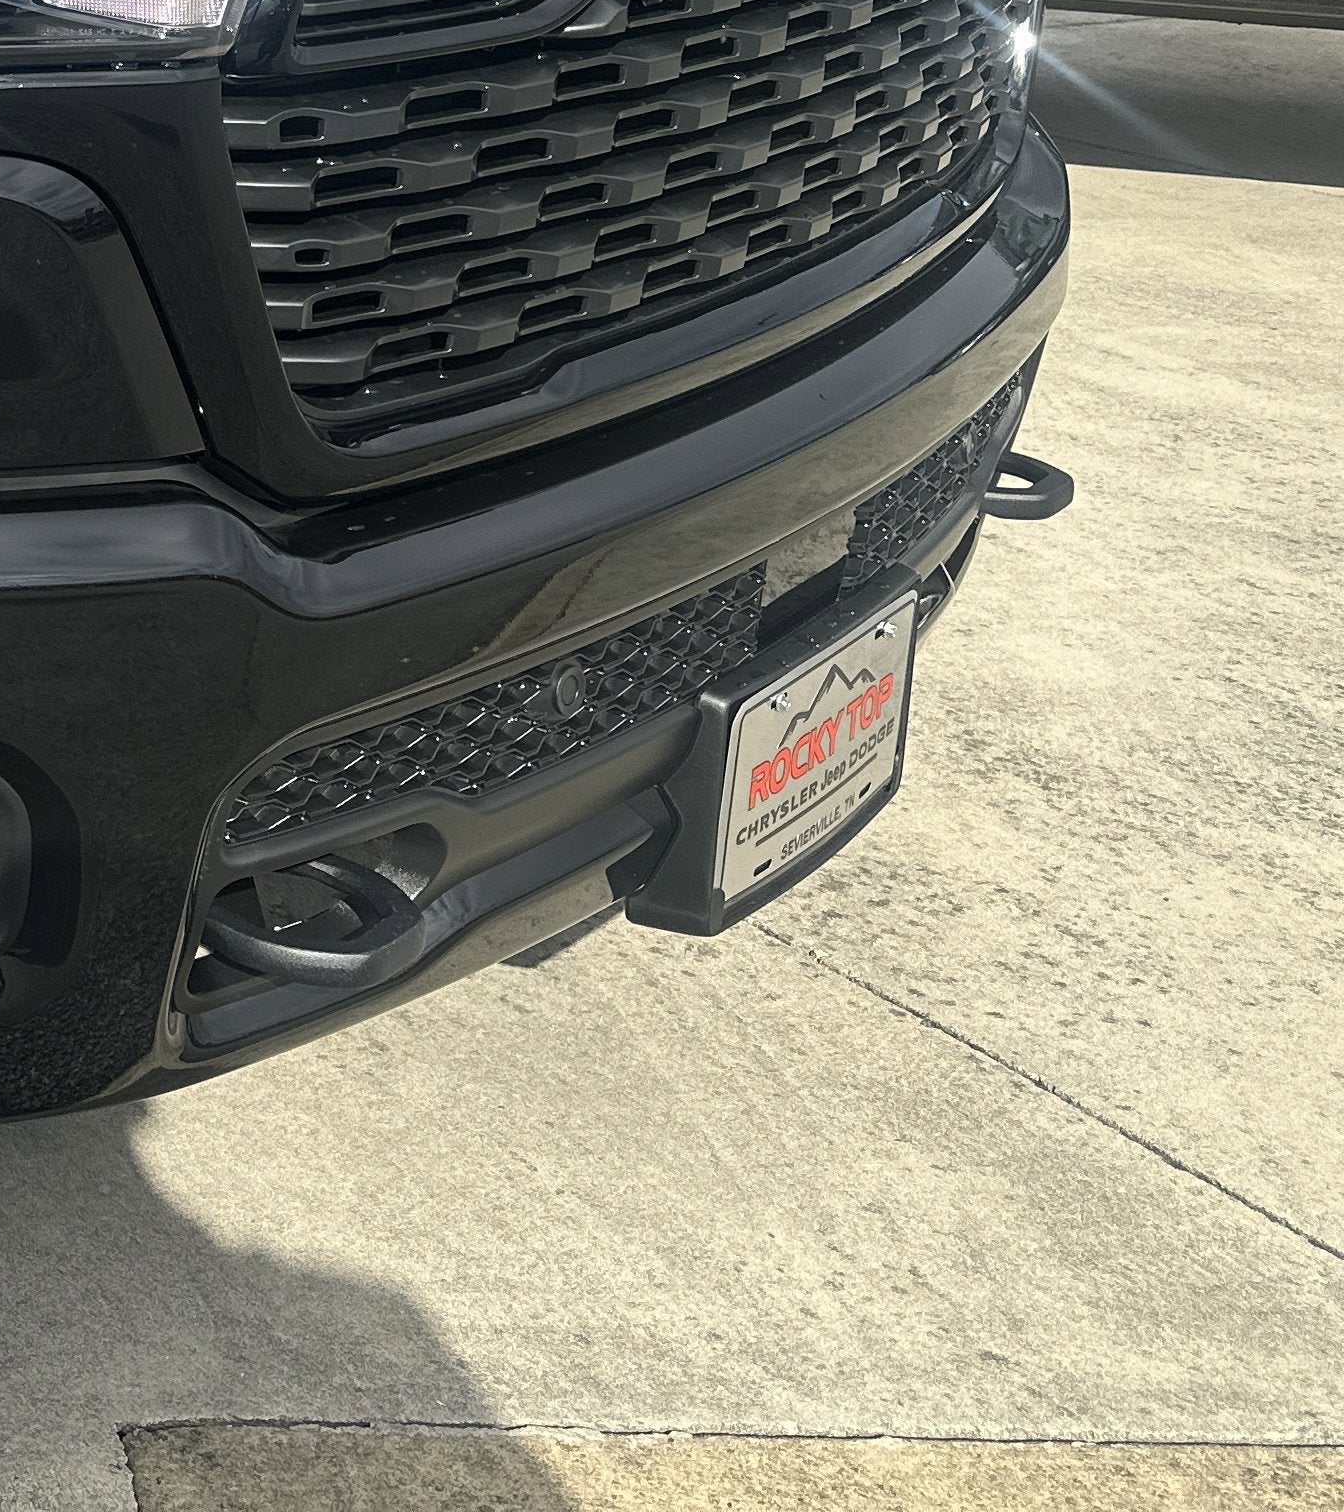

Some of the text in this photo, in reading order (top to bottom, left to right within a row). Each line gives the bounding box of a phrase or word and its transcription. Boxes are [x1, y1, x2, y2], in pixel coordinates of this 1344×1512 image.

[736, 717, 895, 846] CHRYSLER Jeep DODGE
[747, 672, 896, 811] ROCKY TOP
